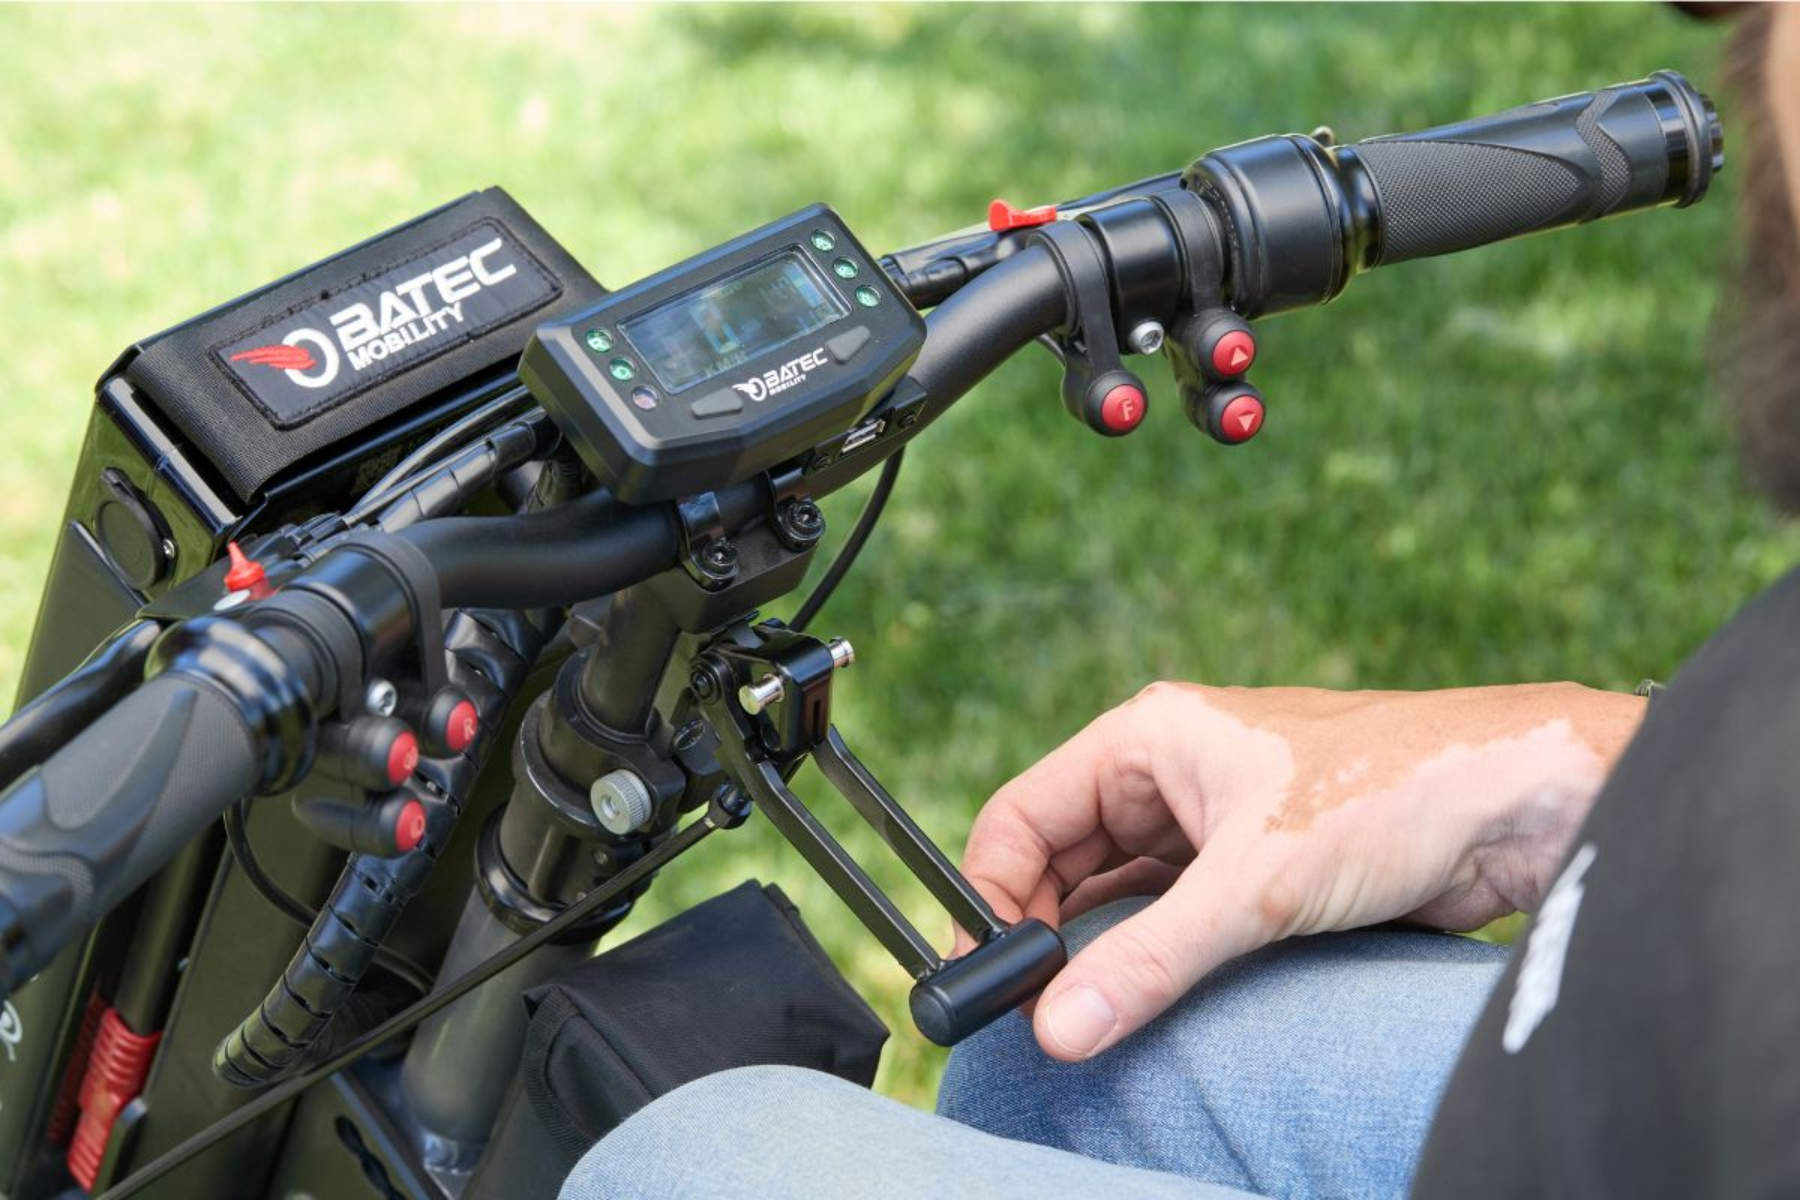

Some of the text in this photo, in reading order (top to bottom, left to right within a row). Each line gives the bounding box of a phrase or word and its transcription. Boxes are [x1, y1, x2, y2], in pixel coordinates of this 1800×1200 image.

[329, 237, 517, 352] BATEC
[346, 301, 465, 371] MOBILITY
[762, 347, 829, 389] BATEC
[1120, 398, 1135, 421] F
[463, 716, 475, 741] R
